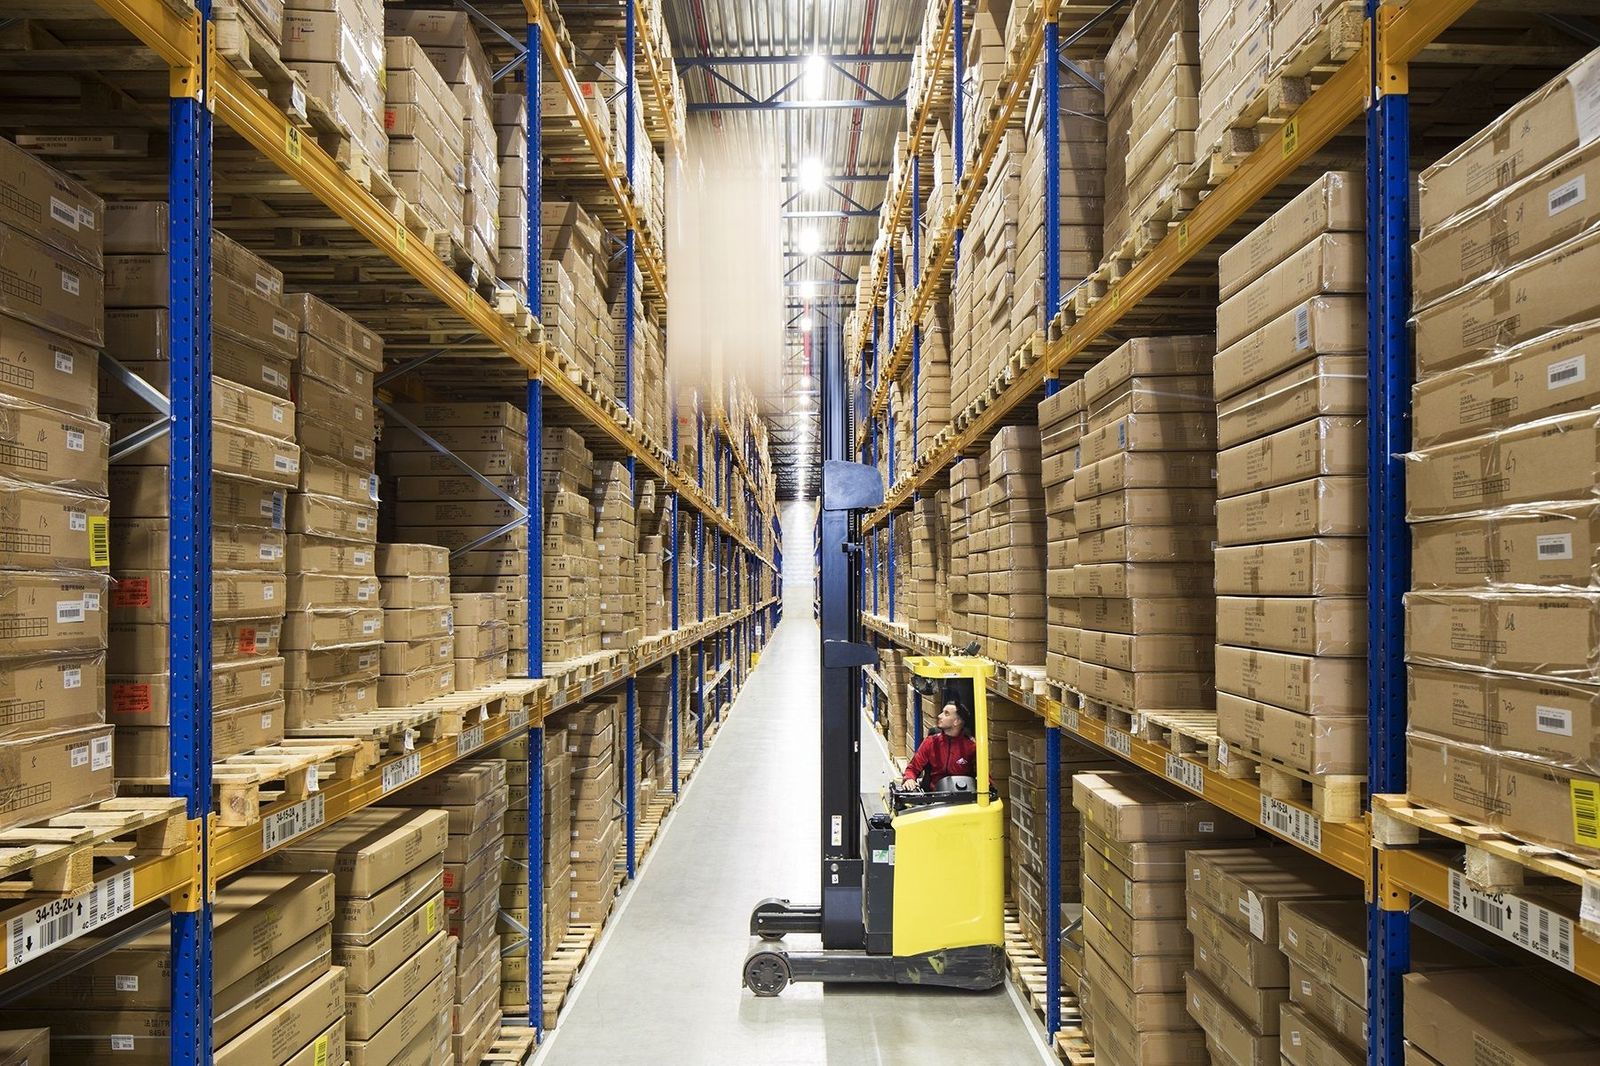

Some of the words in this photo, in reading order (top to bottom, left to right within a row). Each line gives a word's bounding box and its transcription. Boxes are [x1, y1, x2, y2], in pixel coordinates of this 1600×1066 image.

[289, 127, 299, 145] 4A
[1285, 122, 1295, 138] 4A
[36, 897, 74, 924] 34-13-2C
